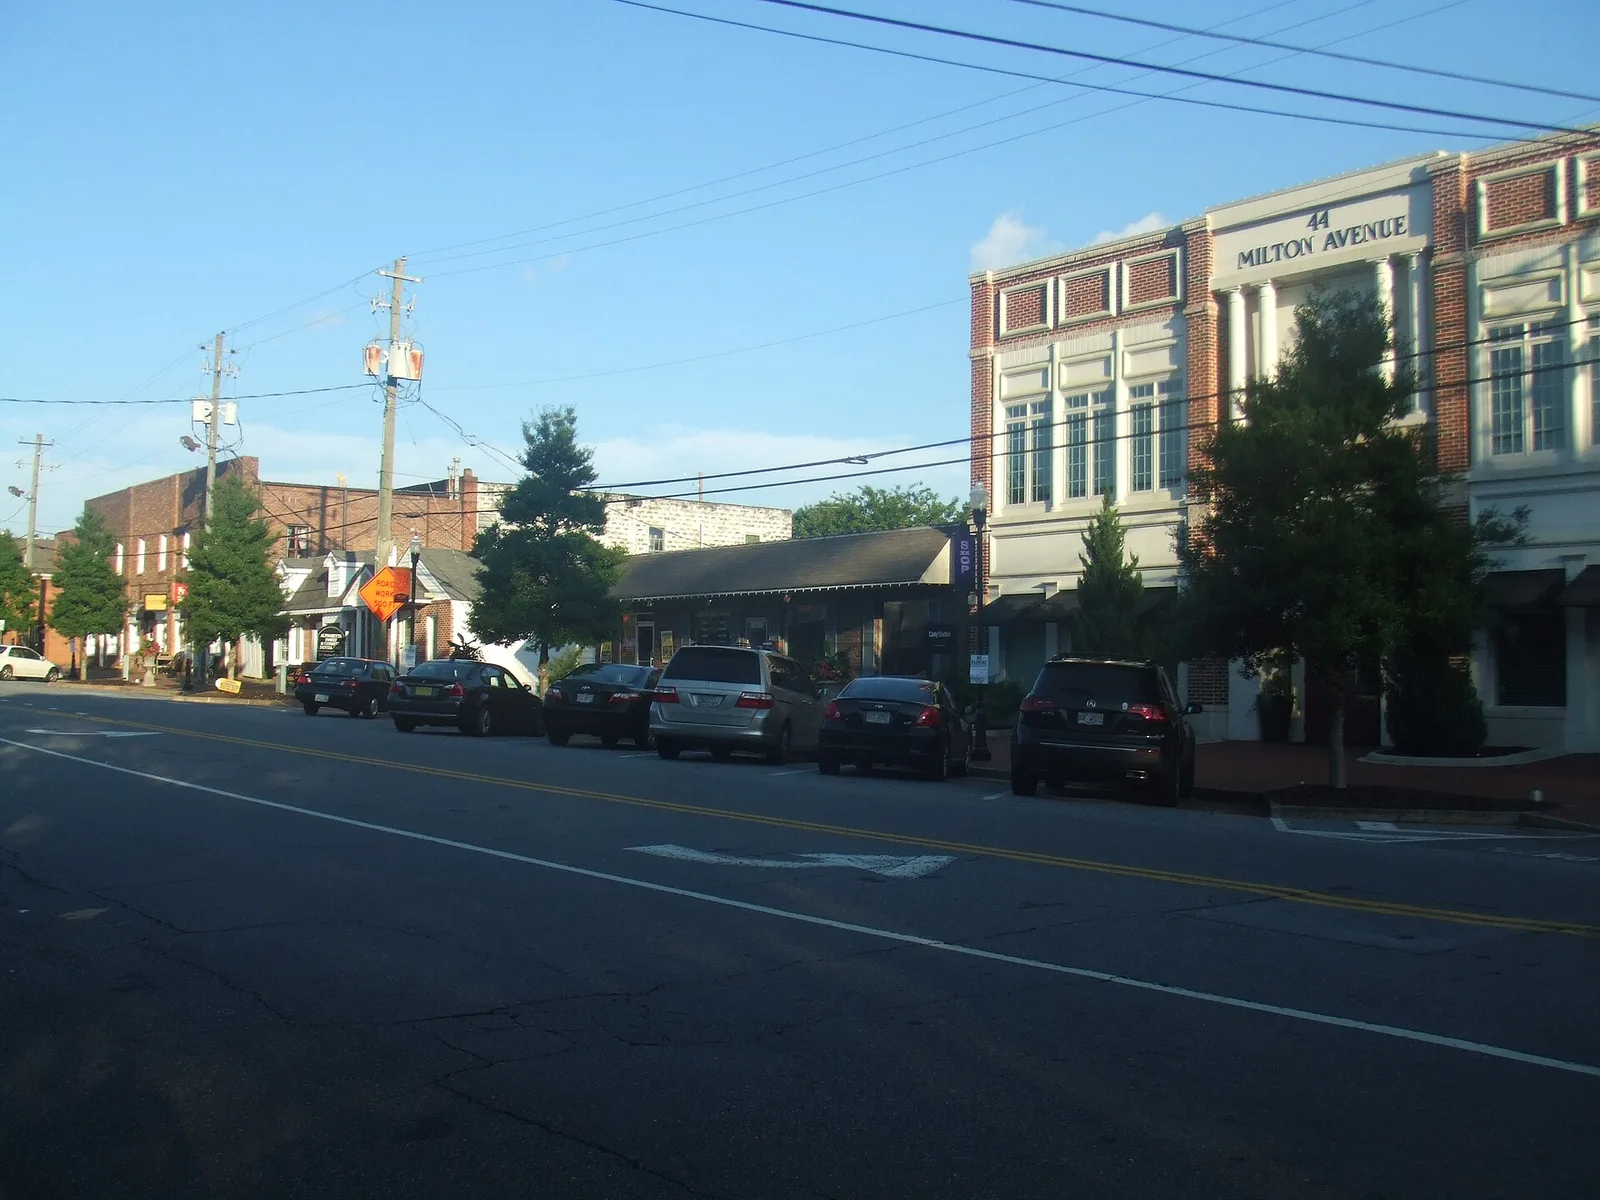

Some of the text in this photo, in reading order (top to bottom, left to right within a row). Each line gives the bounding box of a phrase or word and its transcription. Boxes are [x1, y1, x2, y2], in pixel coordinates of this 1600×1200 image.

[1306, 210, 1330, 231] 44
[1237, 215, 1407, 269] MILTON AVENUE
[960, 540, 970, 574] SHOP
[376, 580, 395, 588] ROAD
[376, 590, 395, 598] WORK
